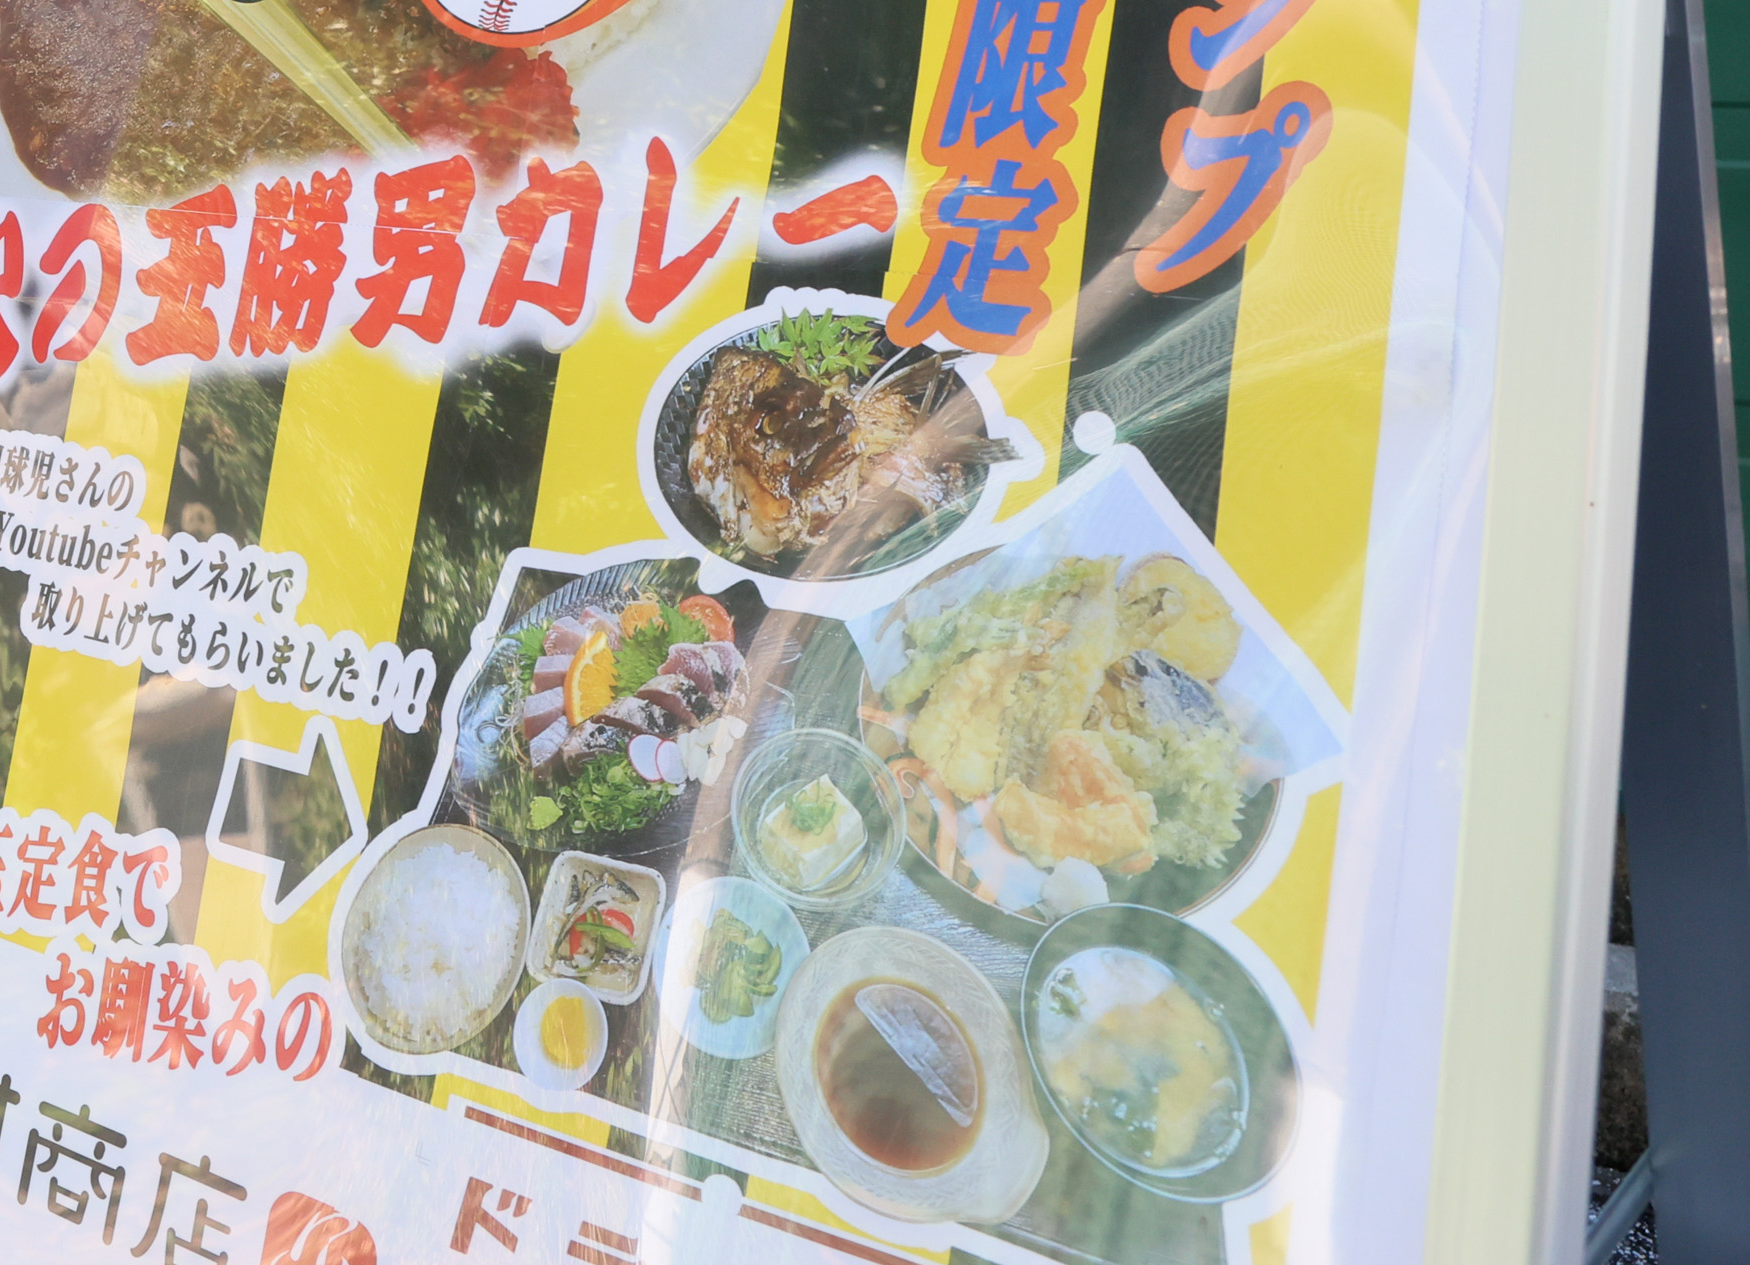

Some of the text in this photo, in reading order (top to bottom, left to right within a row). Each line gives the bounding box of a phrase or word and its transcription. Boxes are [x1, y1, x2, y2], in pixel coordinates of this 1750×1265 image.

[36, 951, 334, 1083] お馴染みの
